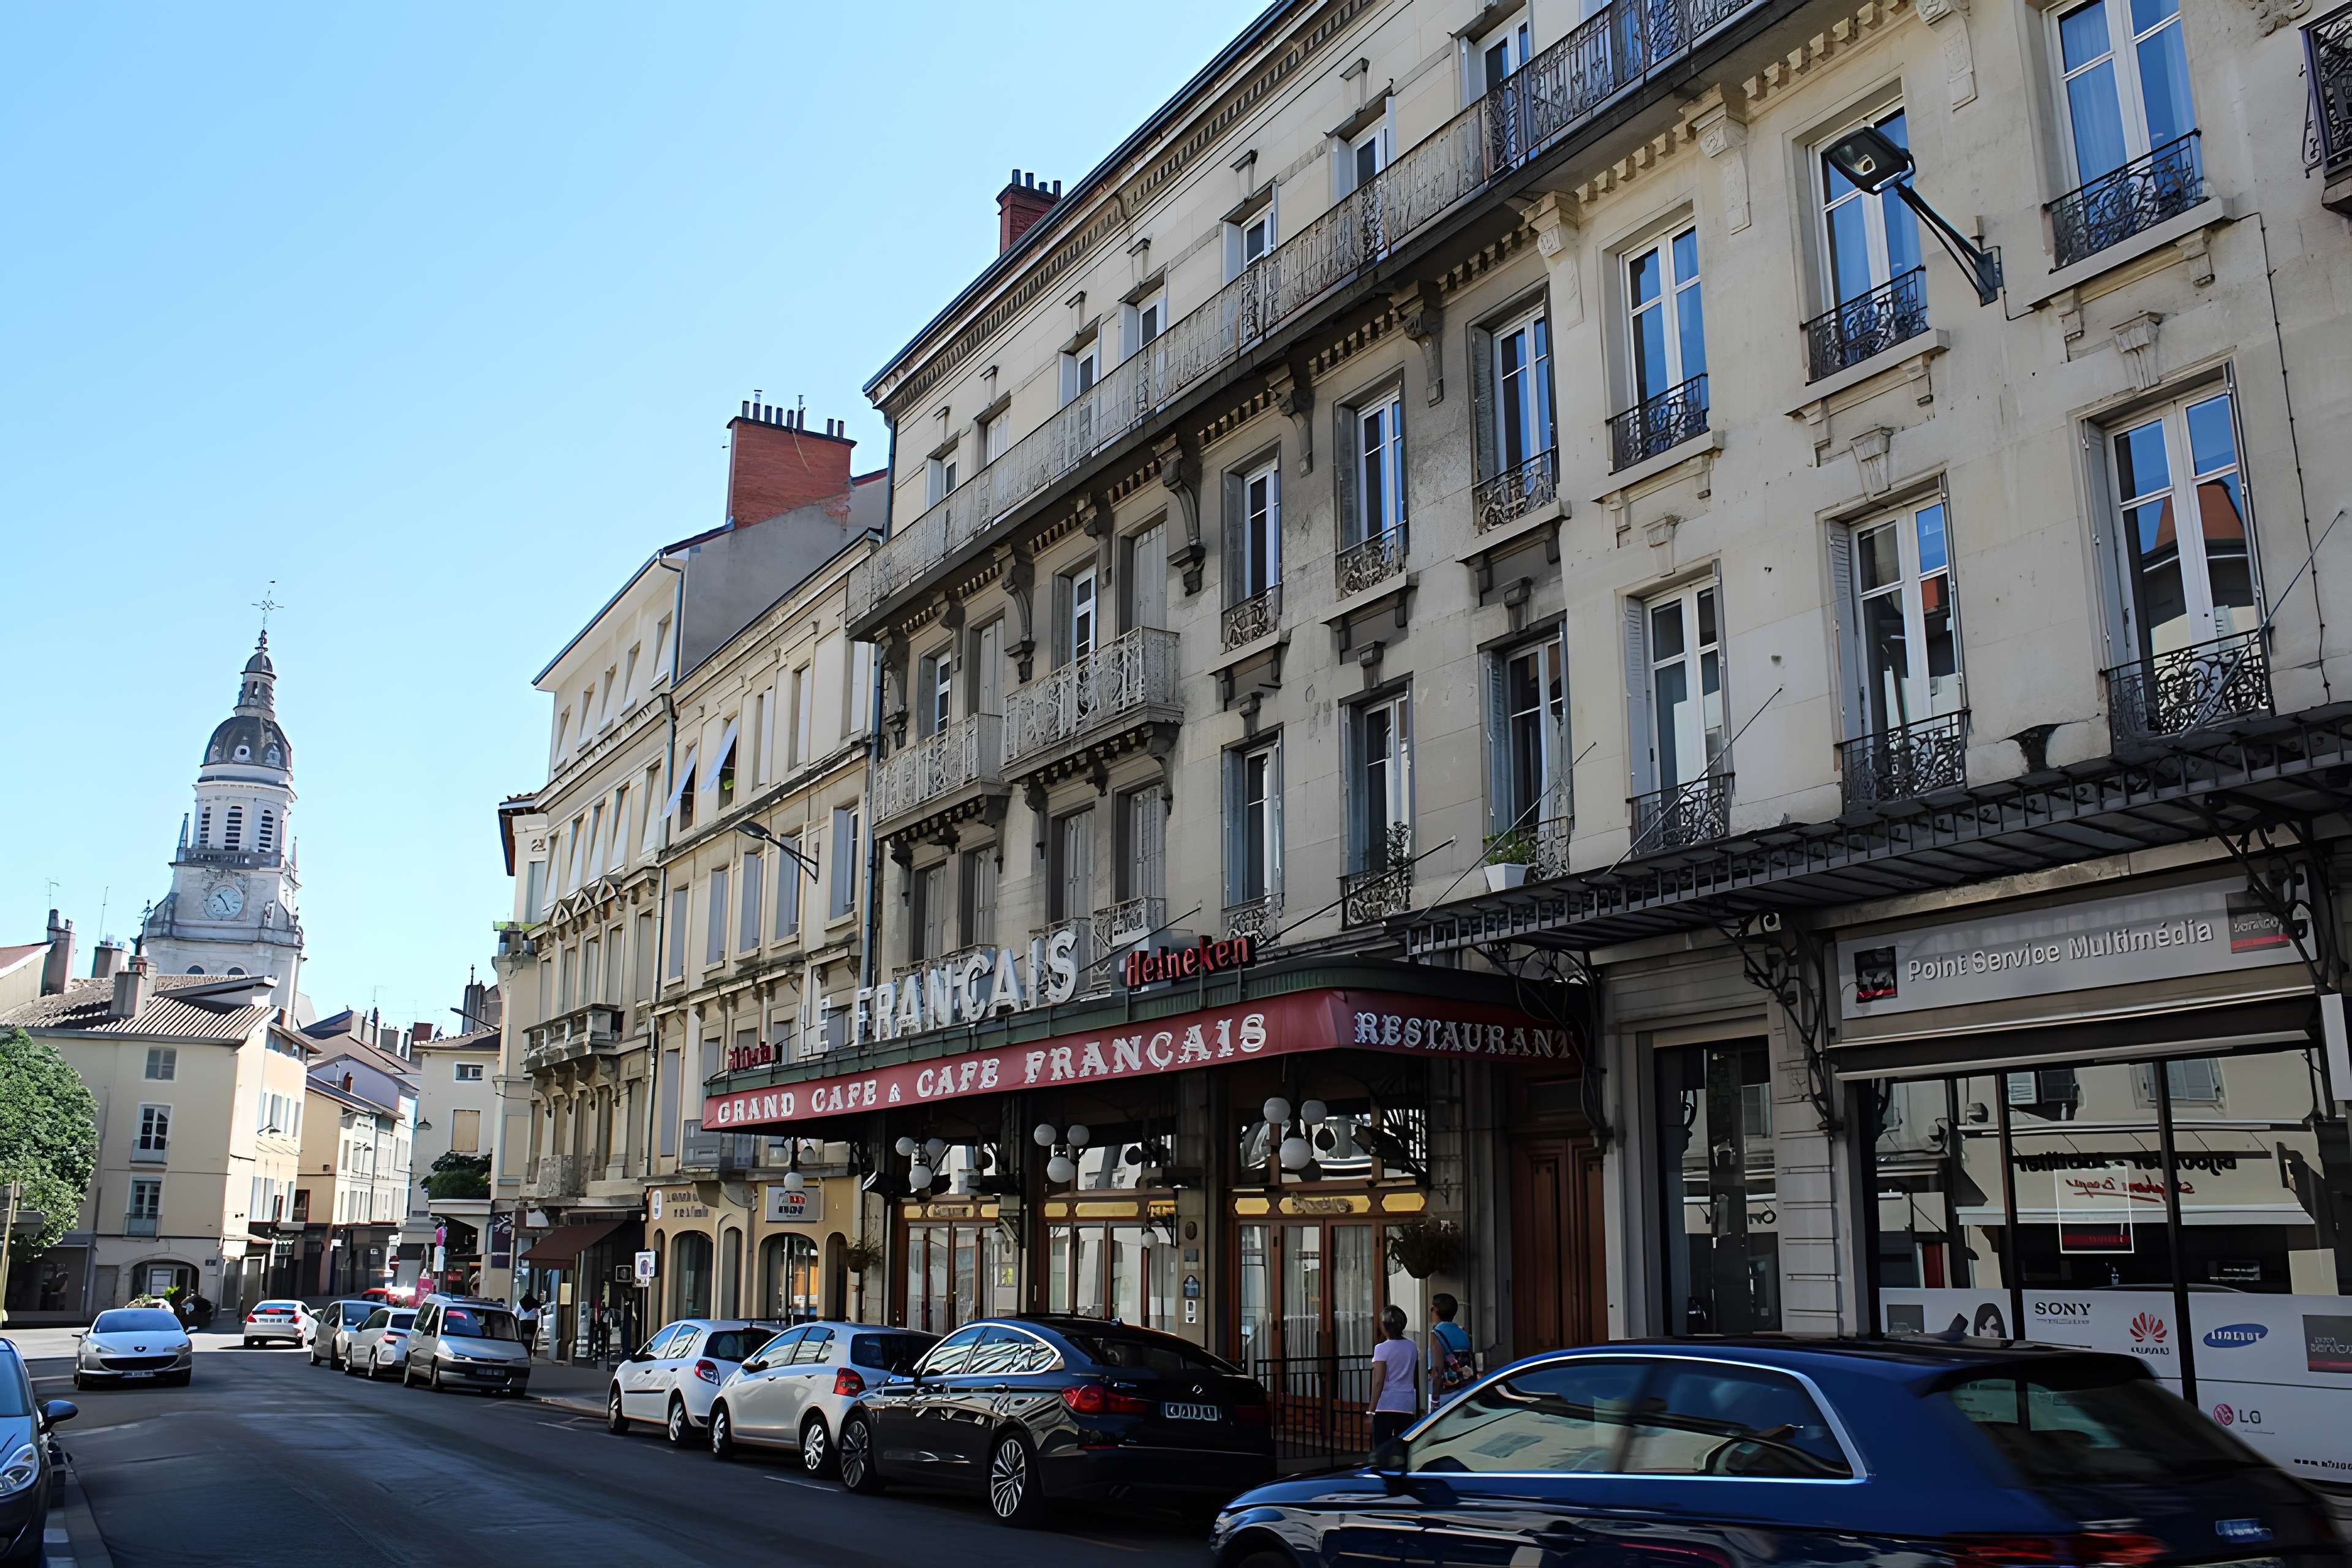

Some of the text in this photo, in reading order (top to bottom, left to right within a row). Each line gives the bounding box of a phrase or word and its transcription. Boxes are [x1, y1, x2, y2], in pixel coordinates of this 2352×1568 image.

[1126, 935, 1248, 987] Heineken
[1909, 955, 1968, 982] Point
[1972, 943, 2060, 973] Service
[2068, 919, 2214, 960] Multimédia
[1354, 1011, 1573, 1058] RESTAURANT
[718, 1092, 794, 1123] GRAND
[2035, 1302, 2091, 1316] SONY
